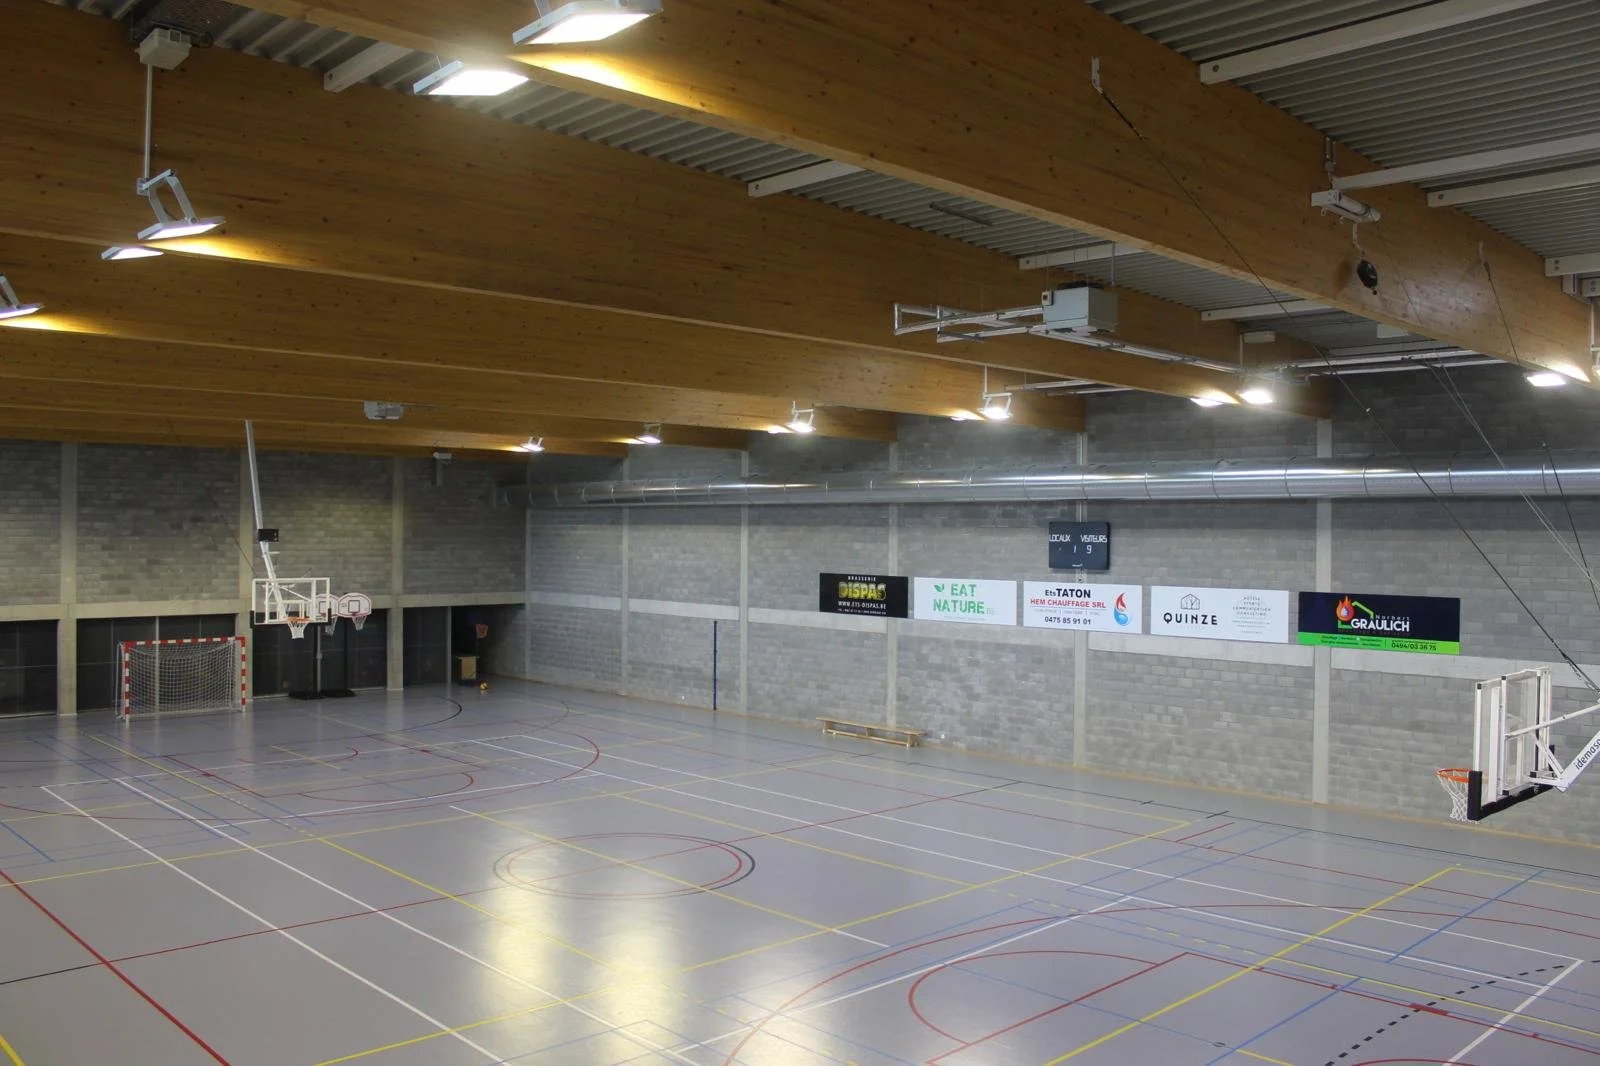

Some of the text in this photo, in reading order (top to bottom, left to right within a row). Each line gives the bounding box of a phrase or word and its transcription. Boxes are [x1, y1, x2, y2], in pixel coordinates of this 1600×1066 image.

[1048, 534, 1108, 543] LOCAUX VISITEURS
[1086, 544, 1092, 554] 9
[950, 583, 977, 597] EAT
[1045, 588, 1091, 598] Ets TATON
[933, 598, 985, 614] NATURE
[1047, 600, 1090, 608] CHAUFFAGE
[1163, 612, 1218, 625] QUINZE
[1350, 618, 1410, 632] GRAULICH
